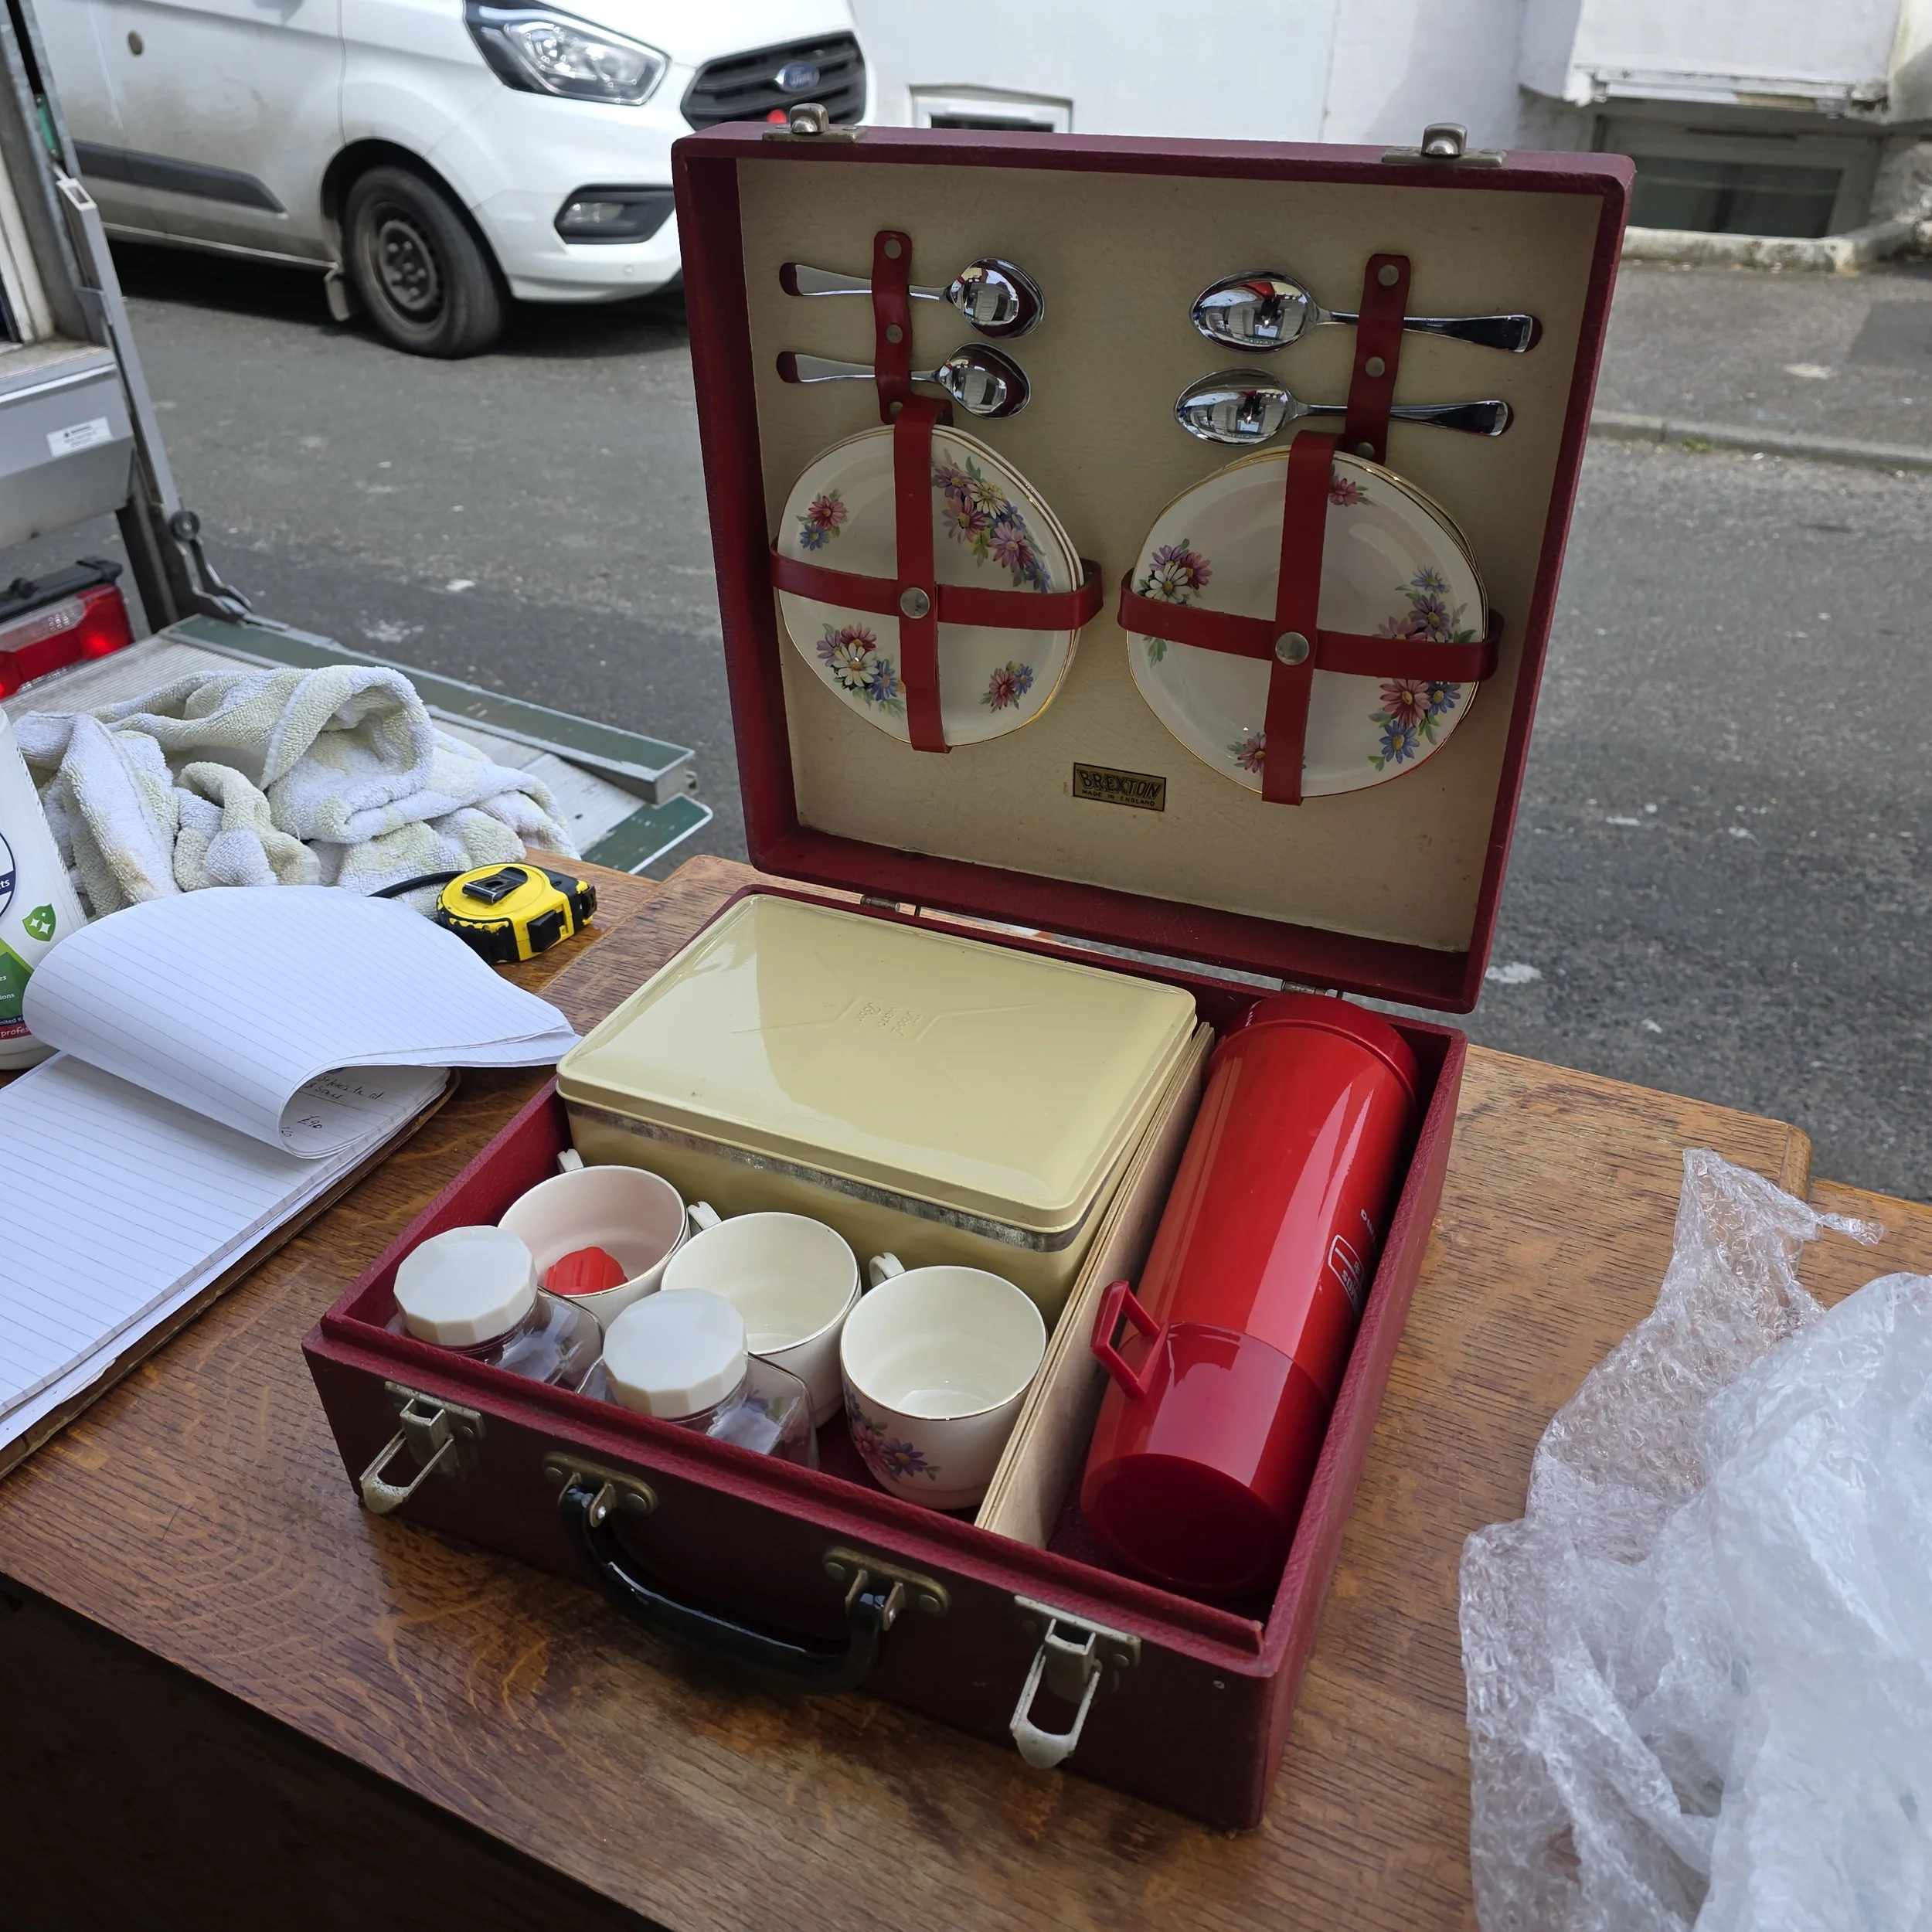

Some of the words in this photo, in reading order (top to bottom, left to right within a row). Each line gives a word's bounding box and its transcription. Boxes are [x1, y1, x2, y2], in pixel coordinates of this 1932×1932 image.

[1077, 769, 1163, 800] BREXTON
[1082, 789, 1102, 798] MADE
[1120, 796, 1155, 807] ENGLAND
[0, 879, 10, 889] ts
